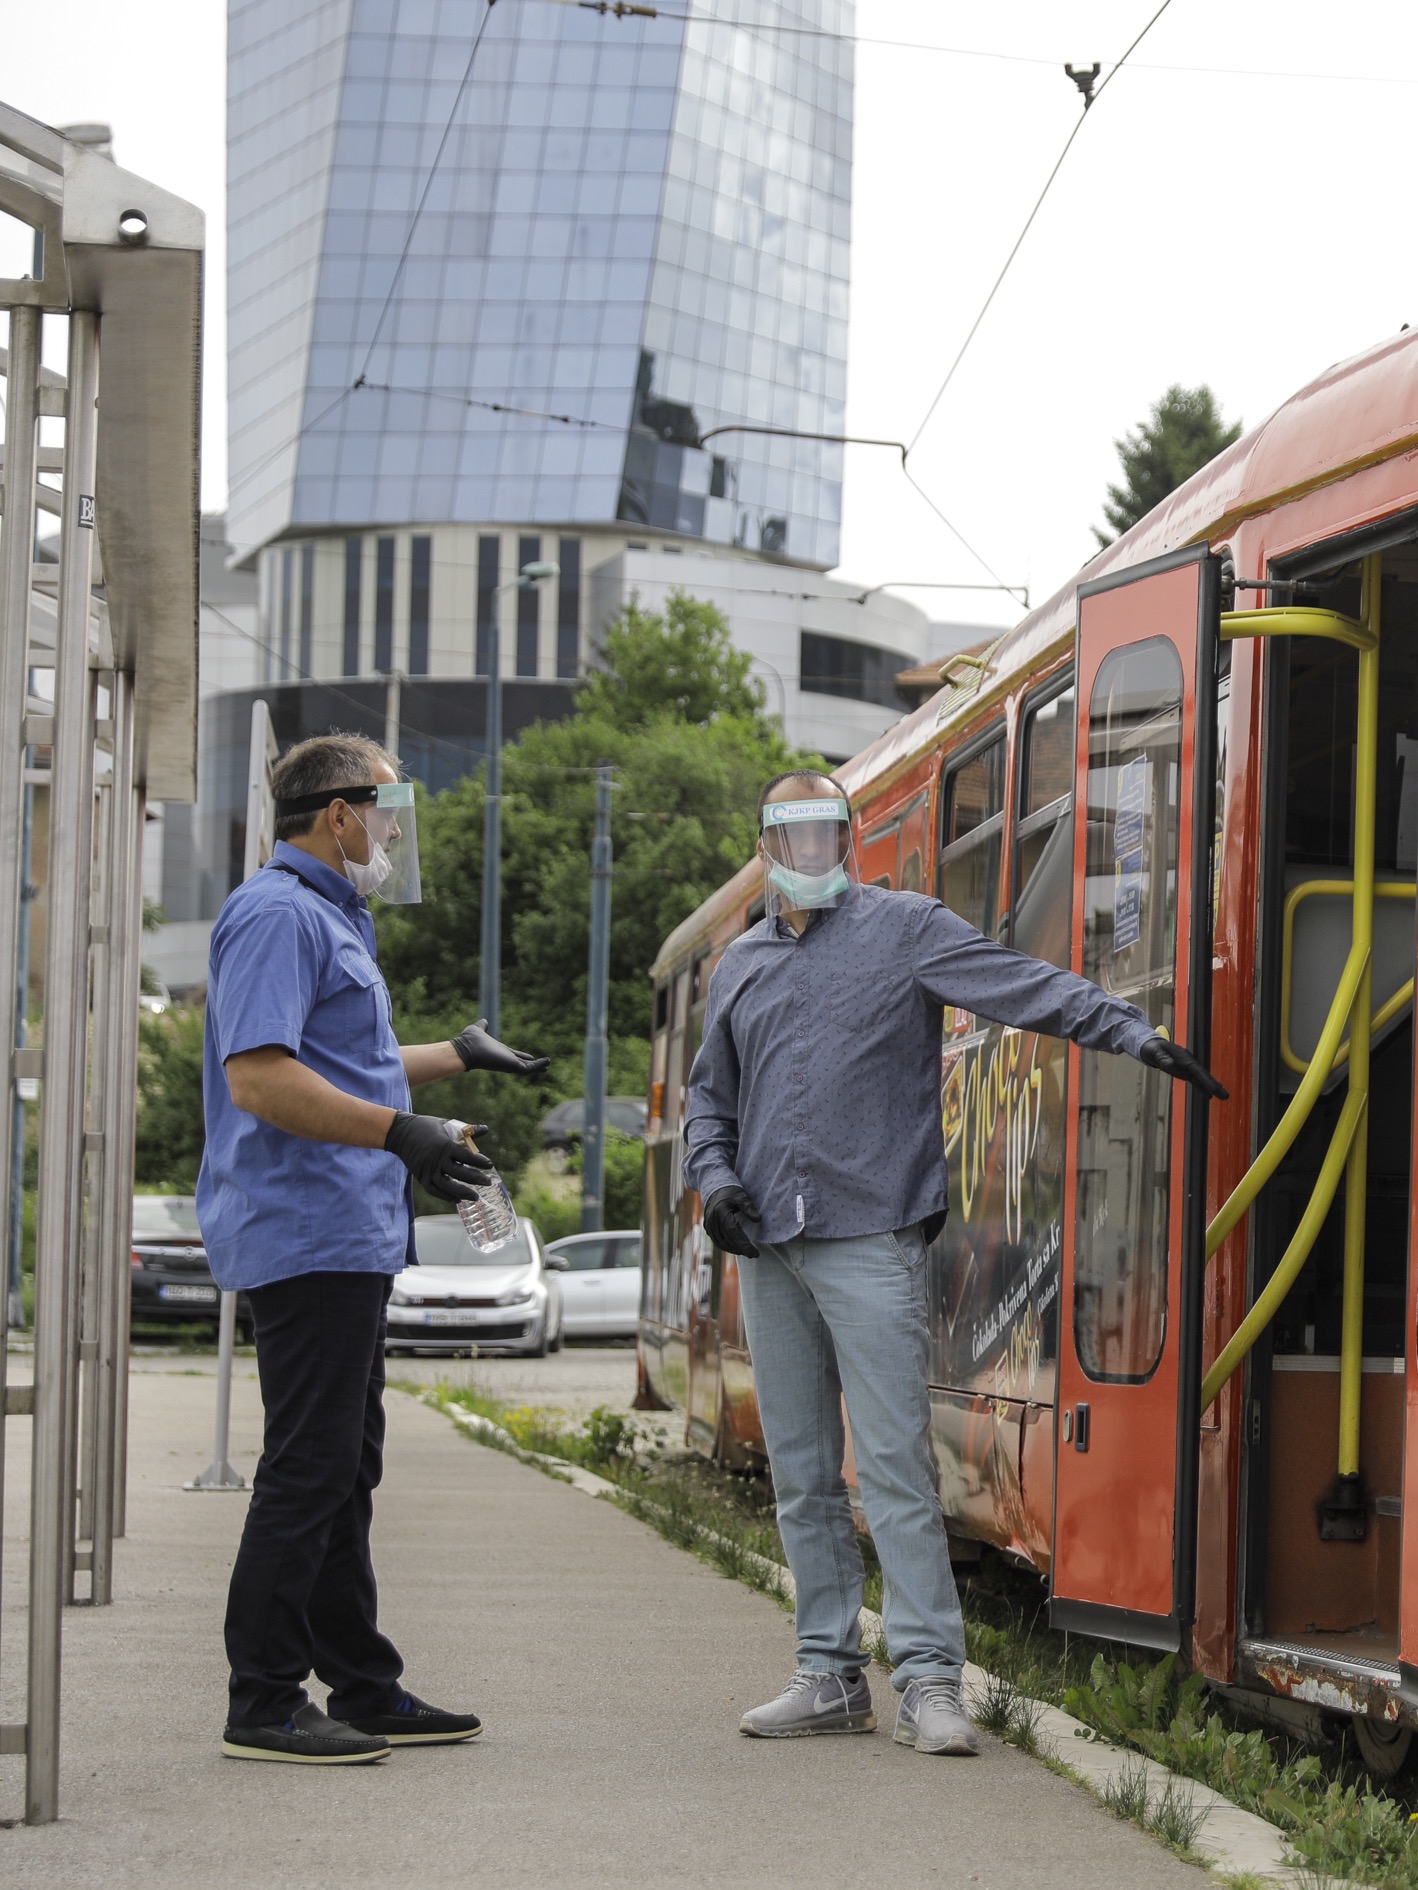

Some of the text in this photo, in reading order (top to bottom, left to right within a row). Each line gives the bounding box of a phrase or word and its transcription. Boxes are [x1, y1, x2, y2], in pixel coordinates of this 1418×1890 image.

[788, 805, 836, 816] KJKP GRAS
[1026, 1257, 1043, 1292] Torta
[1042, 1243, 1050, 1268] sa
